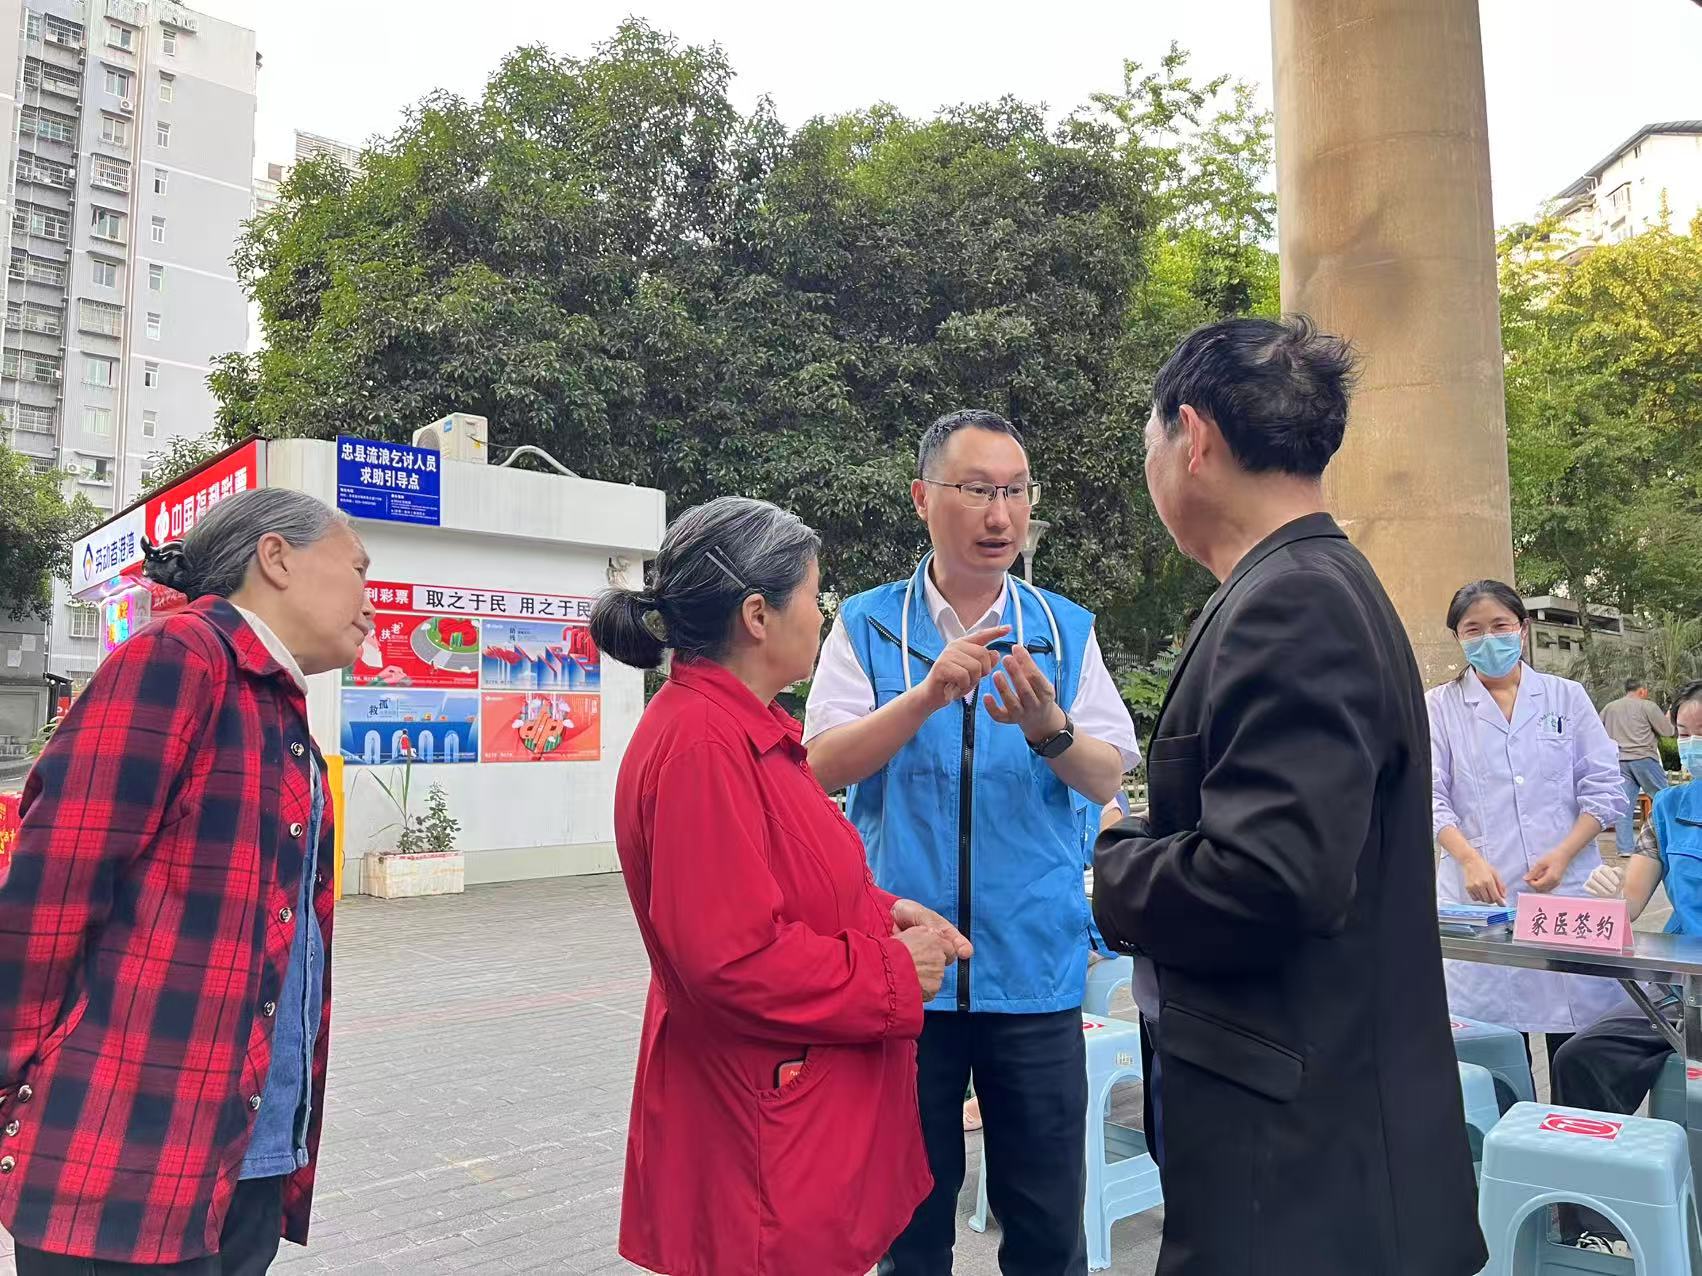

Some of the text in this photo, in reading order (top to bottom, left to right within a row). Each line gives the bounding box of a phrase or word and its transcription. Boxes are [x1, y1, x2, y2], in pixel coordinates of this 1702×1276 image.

[341, 443, 437, 472] 忠县流浪乞讨人员
[360, 467, 419, 490] 求助引导点
[95, 531, 134, 574] 劳动者港湾
[364, 588, 409, 604] 利彩票
[426, 590, 591, 618] 取之于民 用之于民
[1531, 908, 1614, 940] 家医签约
